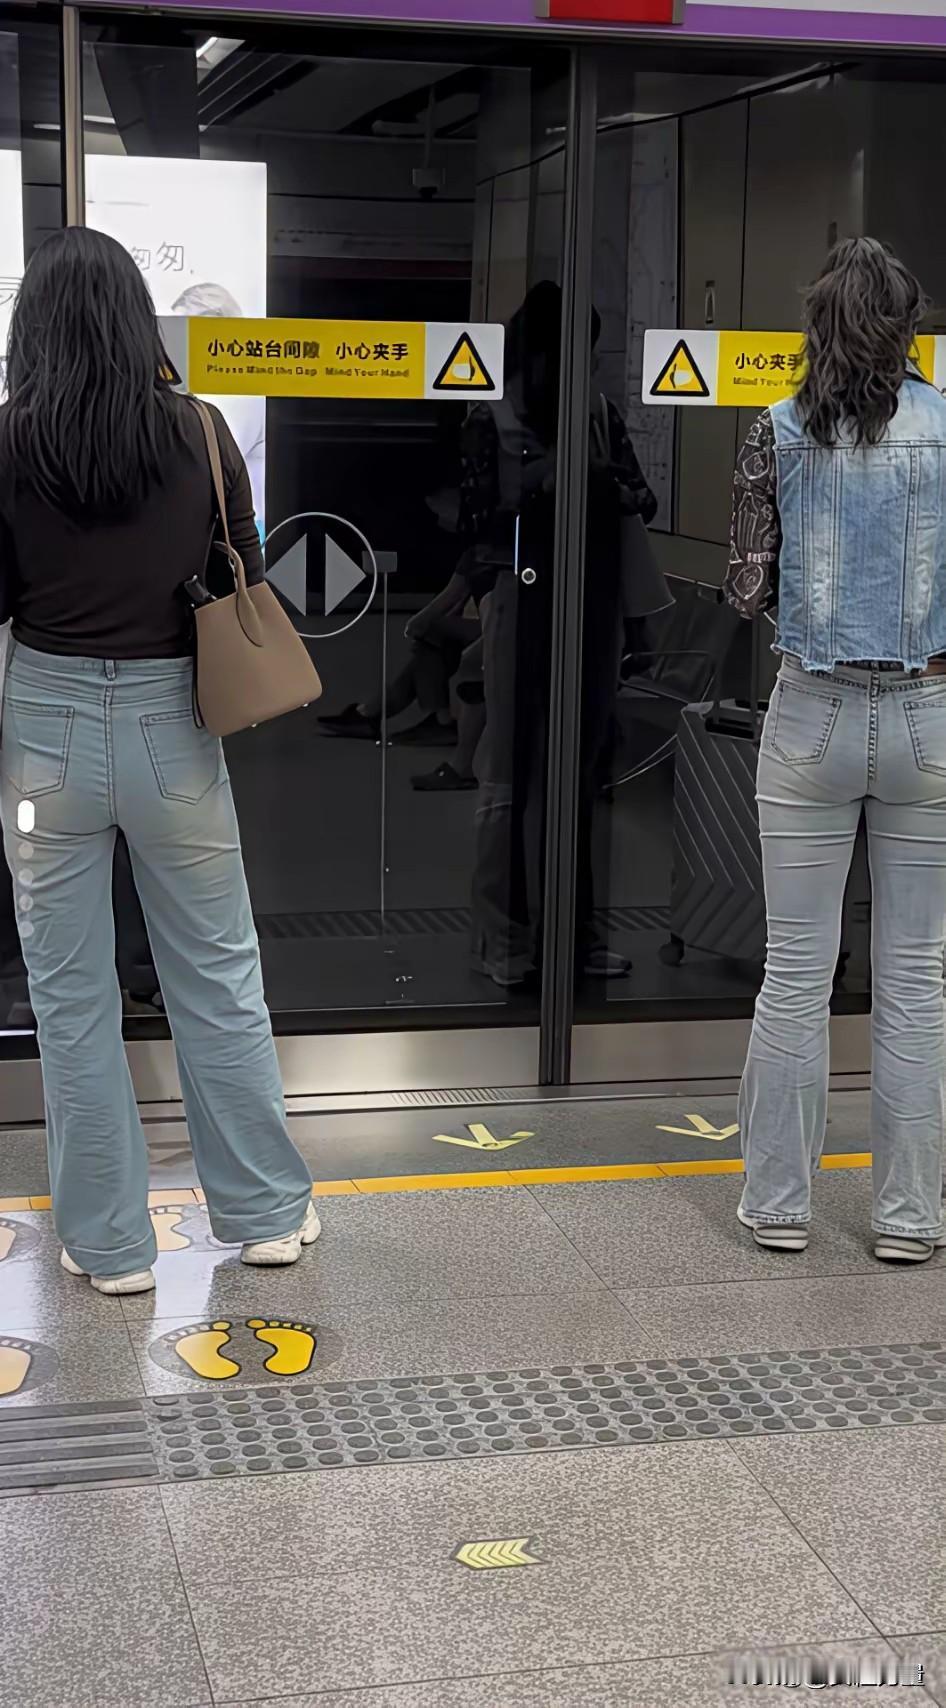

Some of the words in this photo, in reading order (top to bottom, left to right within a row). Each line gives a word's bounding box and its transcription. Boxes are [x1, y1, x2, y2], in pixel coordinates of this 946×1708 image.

[207, 338, 320, 359] 小心站台间隙
[336, 341, 408, 360] 小心夹手
[295, 366, 318, 376] Gap
[325, 367, 352, 376] Mind
